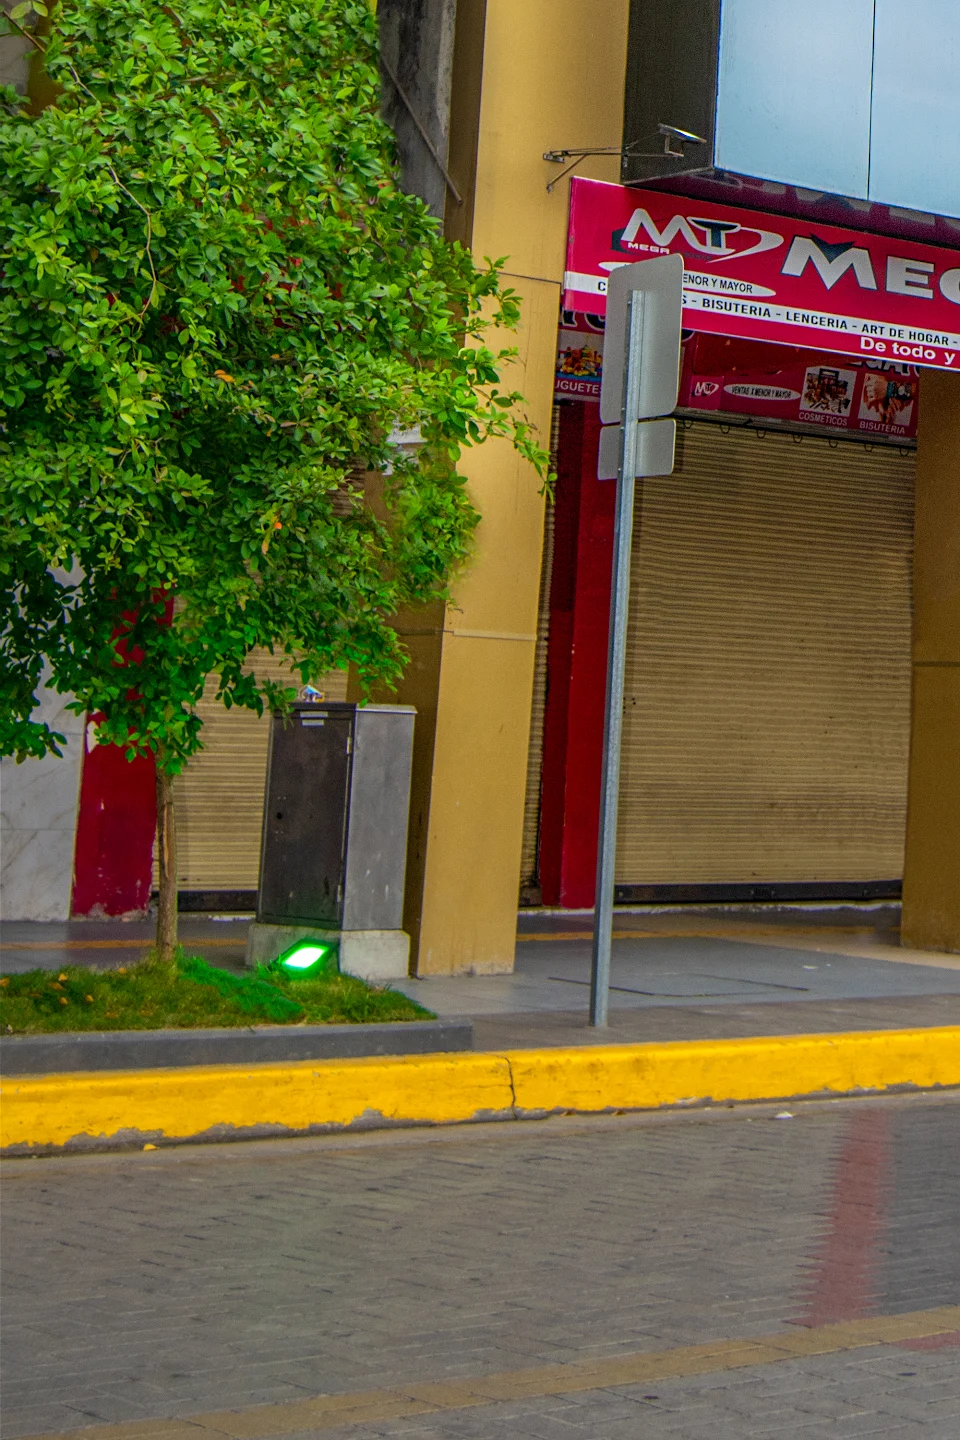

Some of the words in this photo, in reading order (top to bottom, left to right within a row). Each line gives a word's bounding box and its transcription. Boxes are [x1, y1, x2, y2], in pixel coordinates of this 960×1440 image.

[627, 242, 670, 255] MEGA
[683, 273, 709, 287] ENOR
[711, 277, 718, 288] Y
[719, 278, 753, 294] MAYOR
[702, 298, 771, 318] BISUTERIA
[786, 311, 848, 330] LENCERIA
[861, 323, 886, 336] ART
[889, 327, 905, 339] DE
[908, 331, 949, 346] HOGAR
[860, 336, 886, 352] De
[891, 342, 936, 360] todo
[944, 351, 955, 365] y
[555, 380, 602, 394] UGUETE
[731, 385, 750, 396] VENTAS
[755, 387, 771, 397] MENOR
[775, 389, 792, 399] MAYOR
[798, 411, 848, 426] COSMETICOS
[859, 420, 906, 435] BISUTERIA
